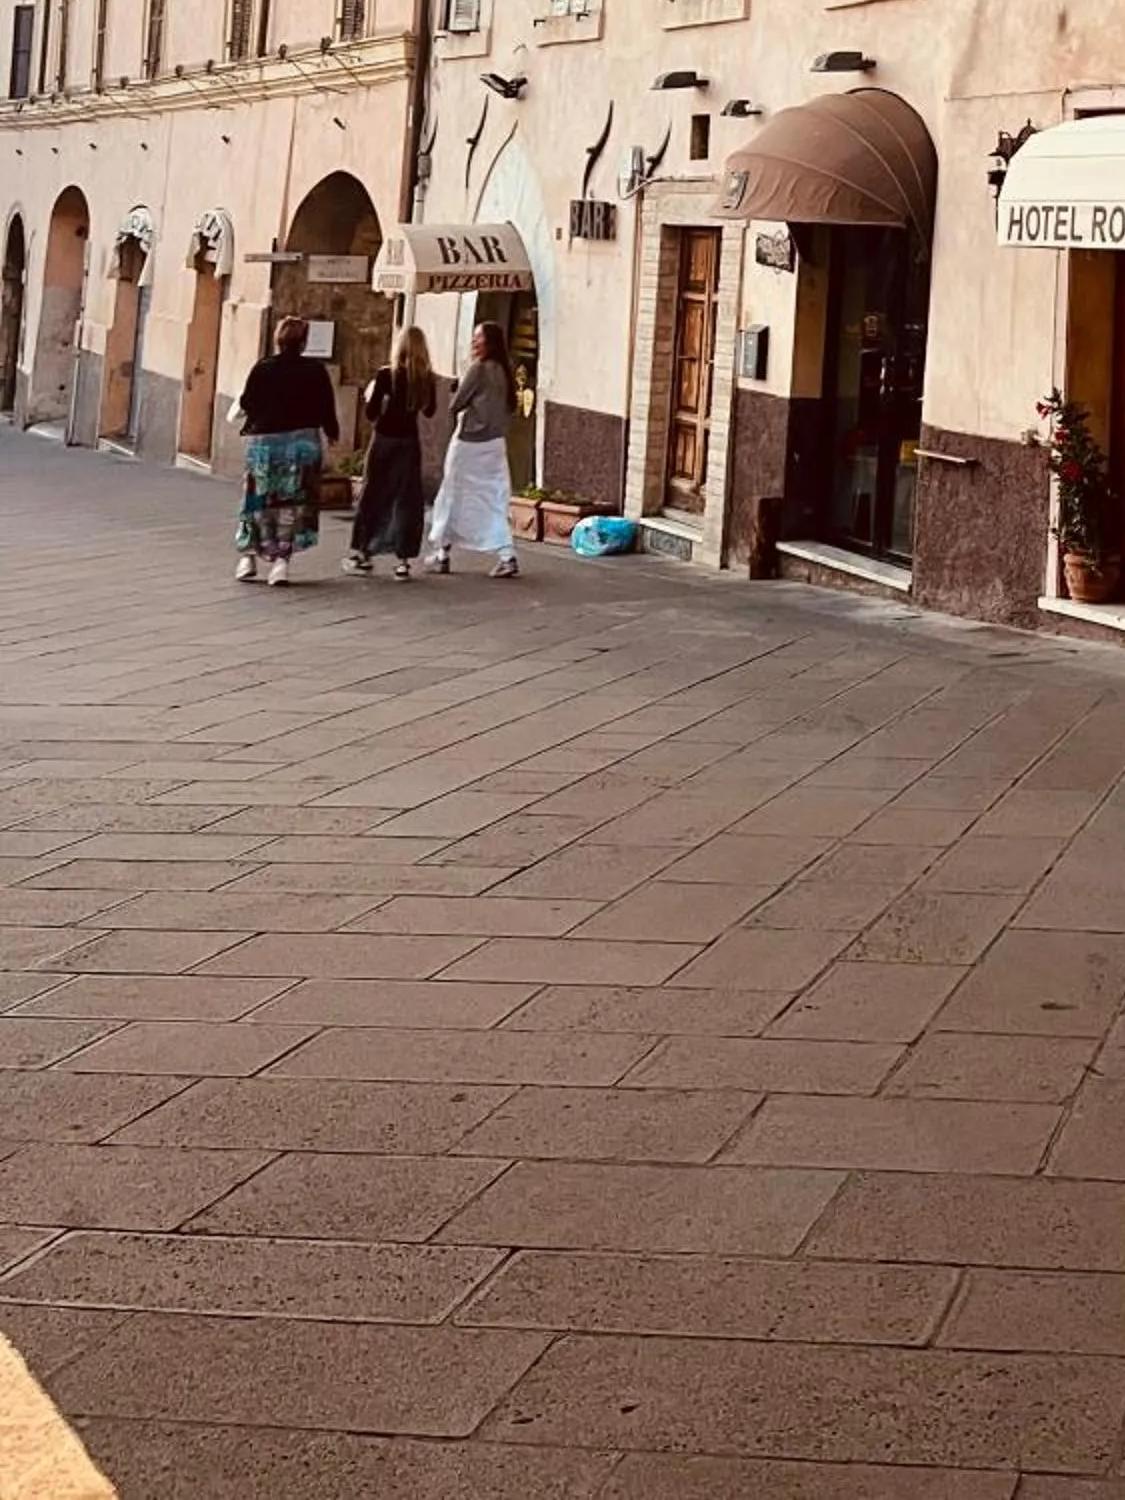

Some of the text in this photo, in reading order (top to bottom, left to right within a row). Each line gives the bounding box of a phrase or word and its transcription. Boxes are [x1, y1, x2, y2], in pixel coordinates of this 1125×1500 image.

[1007, 205, 1083, 243] HOTEL
[437, 235, 508, 265] BAR
[426, 273, 524, 290] PIZZERIA
